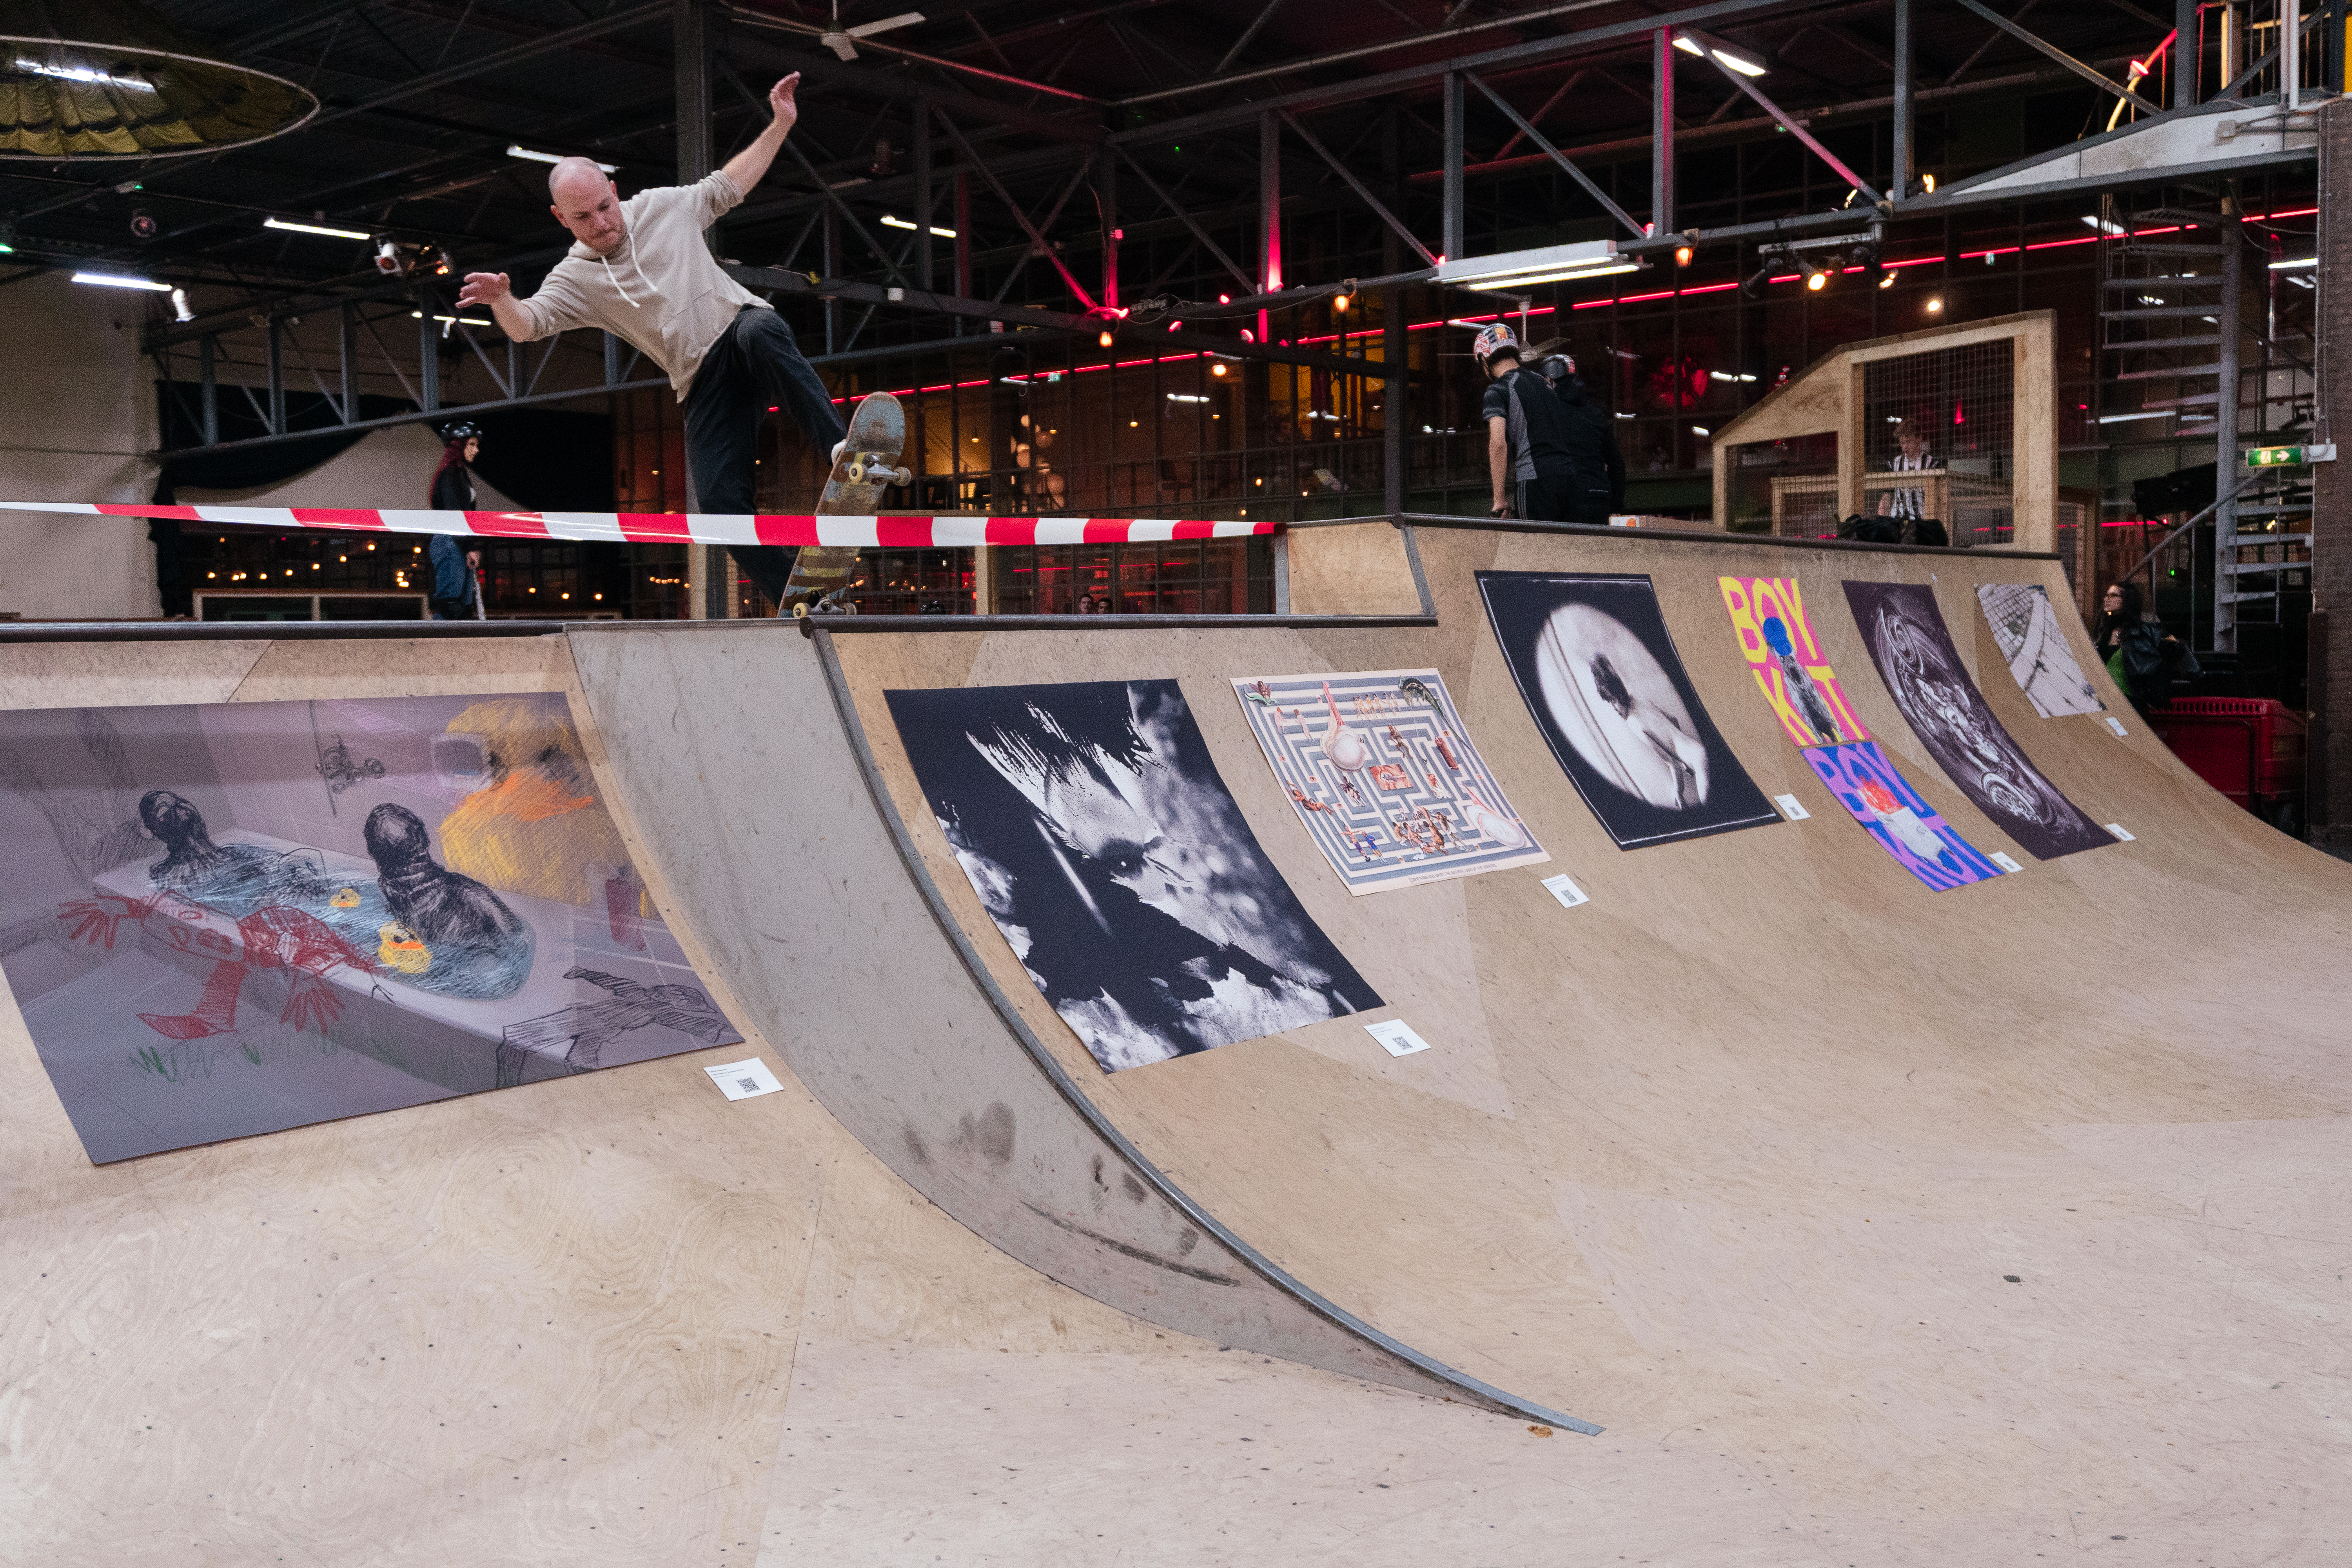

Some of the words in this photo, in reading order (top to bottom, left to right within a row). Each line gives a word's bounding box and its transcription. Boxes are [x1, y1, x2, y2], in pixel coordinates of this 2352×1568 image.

[1719, 576, 1818, 663] BOY
[1753, 665, 1866, 746] KT
[1803, 741, 1924, 823] BOY
